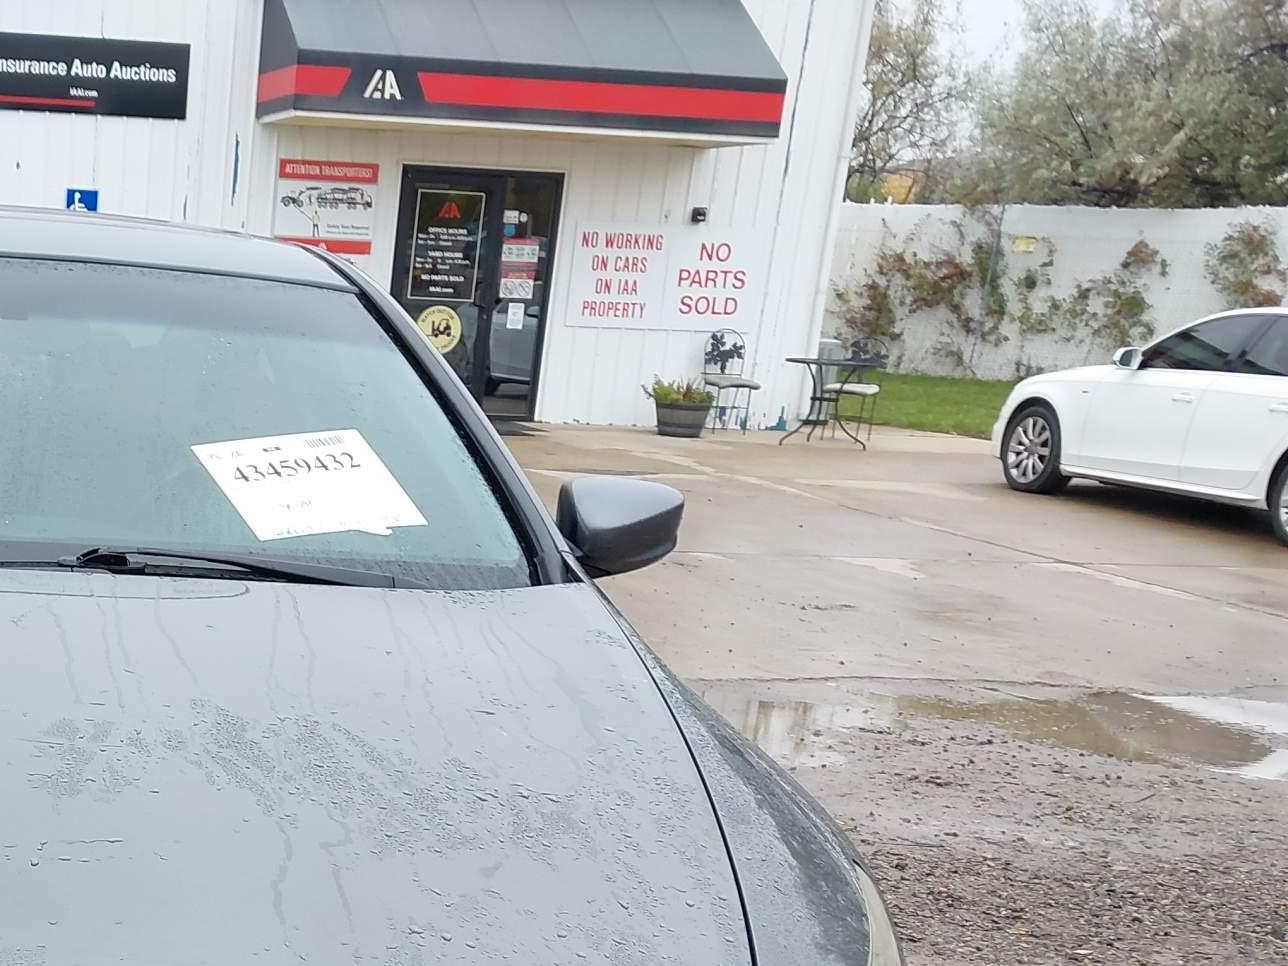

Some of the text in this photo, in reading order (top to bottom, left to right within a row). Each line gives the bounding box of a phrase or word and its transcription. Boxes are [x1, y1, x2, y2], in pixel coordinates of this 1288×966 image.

[70, 58, 107, 79] Auto
[110, 61, 177, 83] Auctions
[582, 231, 664, 251] NO WORKING
[699, 242, 732, 262] NO
[591, 255, 648, 273] ON CARS
[595, 278, 638, 296] ON IAA
[678, 269, 746, 290] PARTS
[581, 300, 646, 319] PROPERTY
[679, 295, 738, 316] SOLD
[233, 452, 361, 482] 43459432
